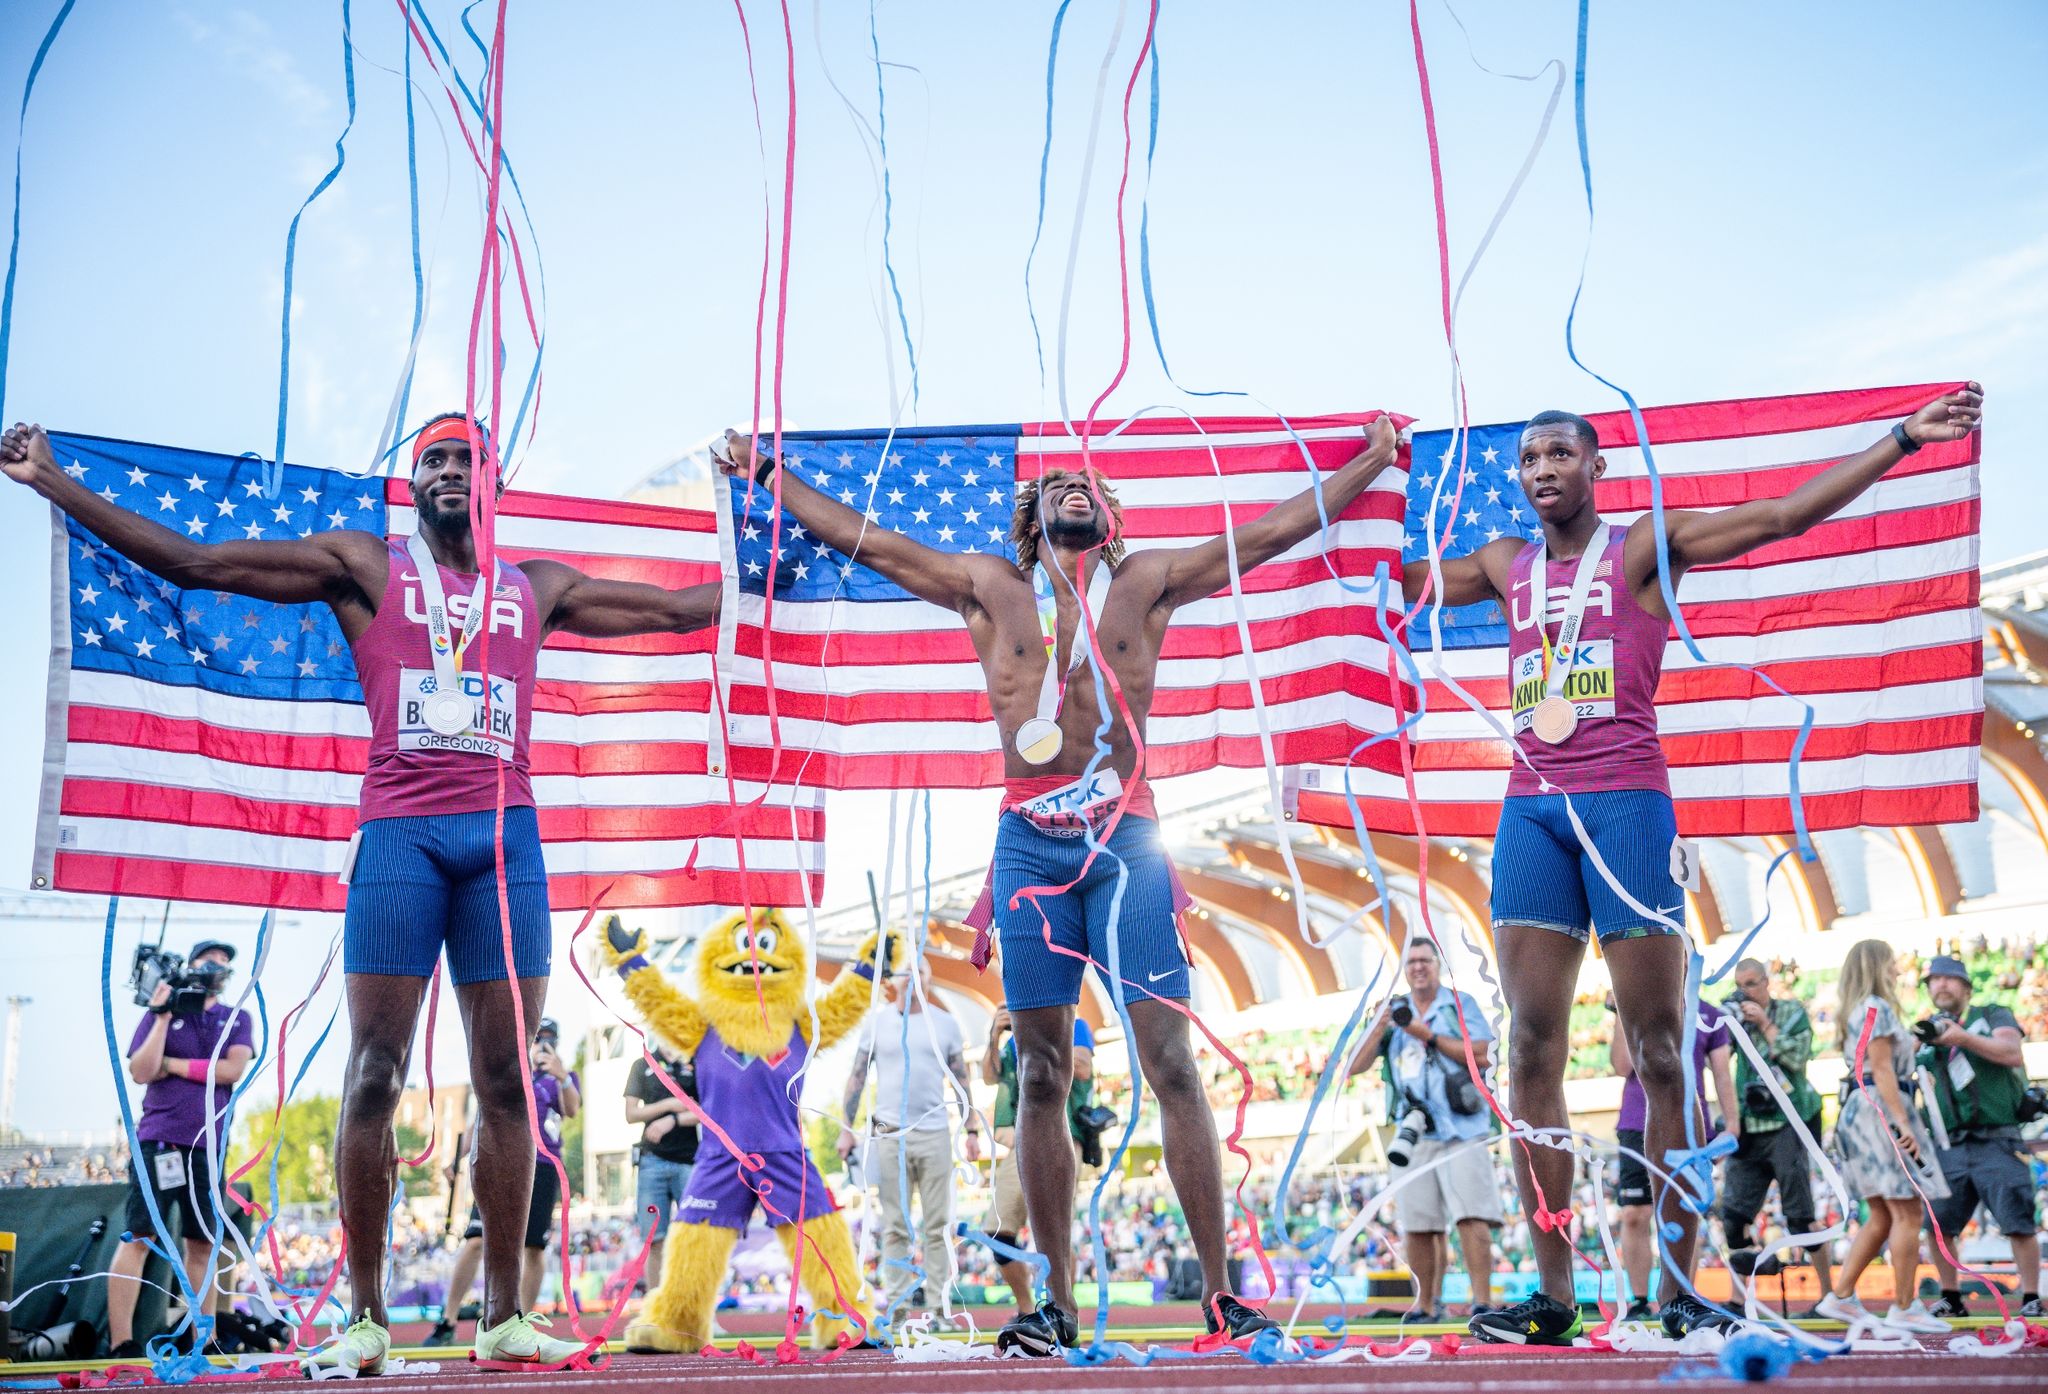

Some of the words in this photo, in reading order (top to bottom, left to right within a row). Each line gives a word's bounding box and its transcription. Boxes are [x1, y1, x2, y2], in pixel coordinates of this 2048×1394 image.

[1516, 671, 1607, 711] KNITON
[406, 701, 513, 737] BREK
[418, 735, 500, 754] OREGON22
